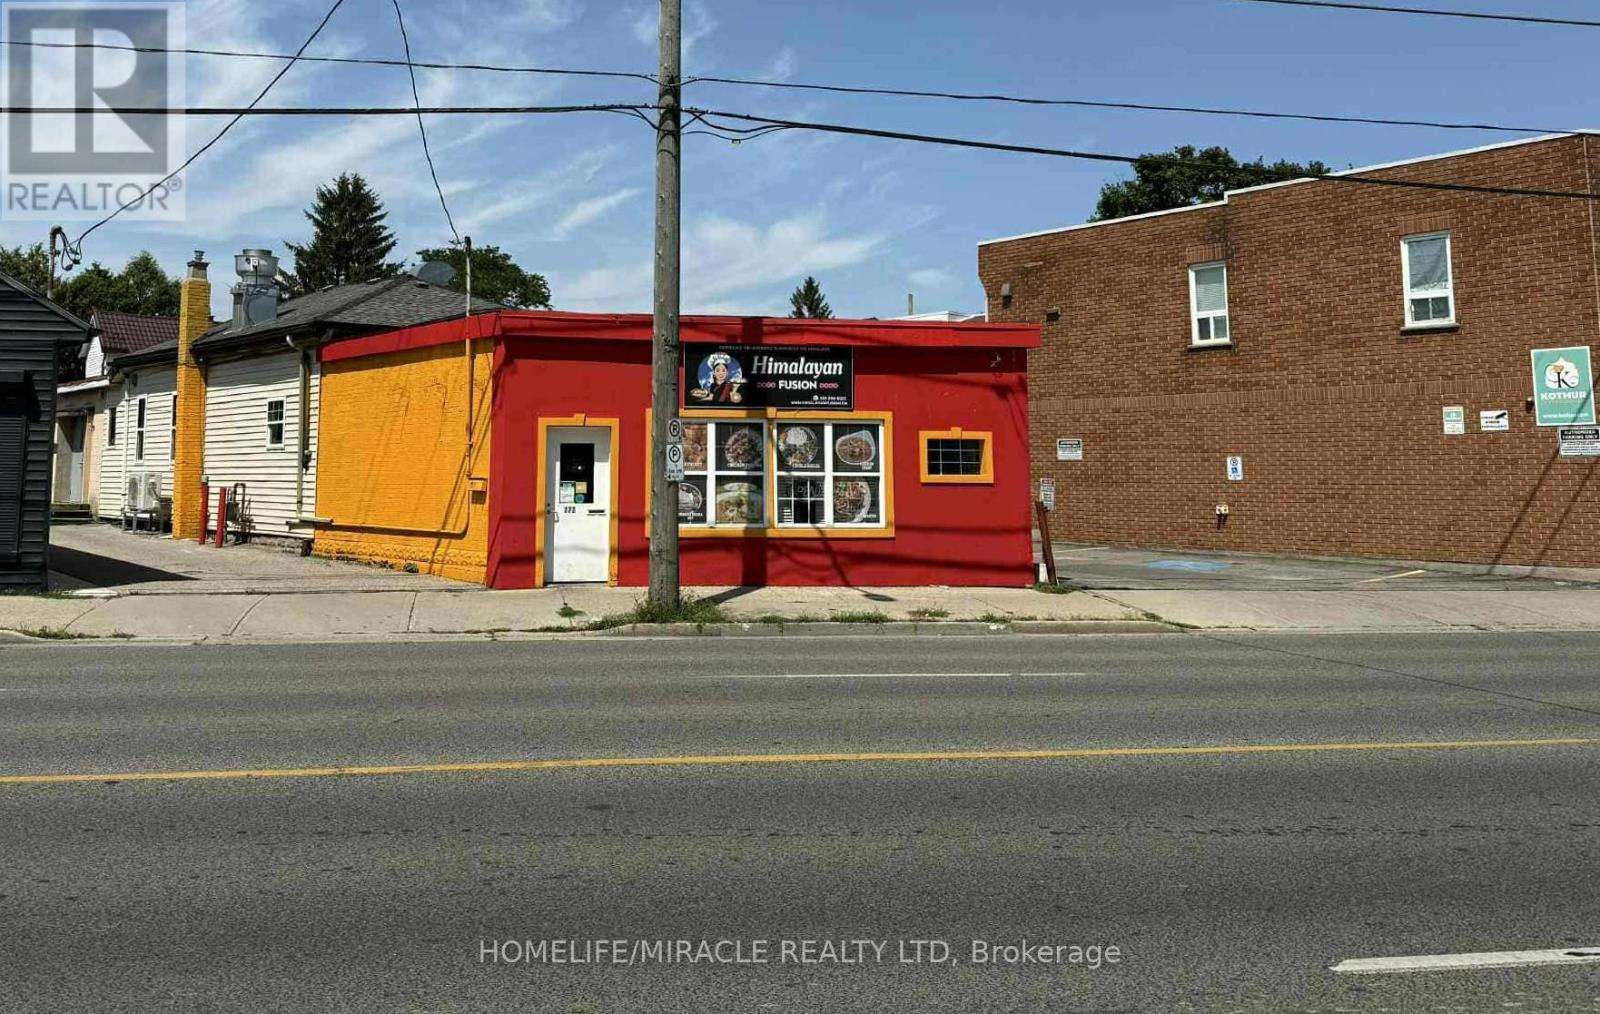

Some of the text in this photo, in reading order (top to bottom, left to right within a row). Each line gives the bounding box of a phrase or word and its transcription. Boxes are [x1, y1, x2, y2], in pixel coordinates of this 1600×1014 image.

[751, 355, 843, 379] Himalayan
[778, 380, 818, 390] FUSION
[1541, 391, 1587, 401] KOTHUR
